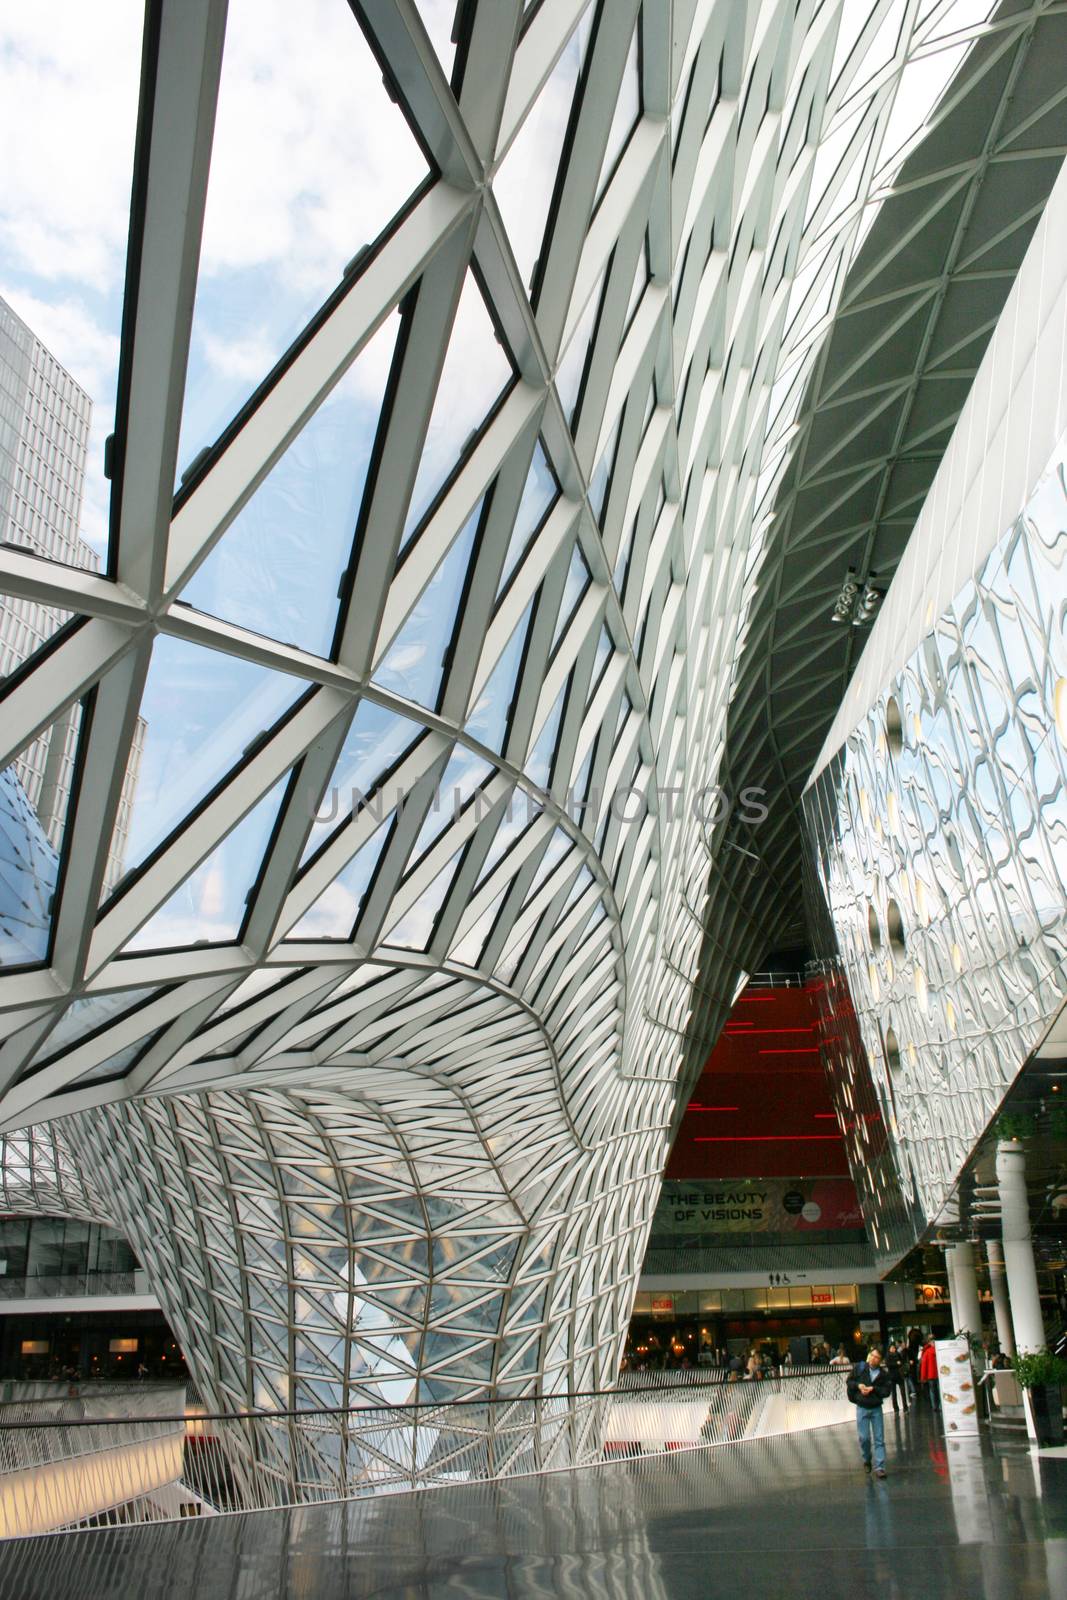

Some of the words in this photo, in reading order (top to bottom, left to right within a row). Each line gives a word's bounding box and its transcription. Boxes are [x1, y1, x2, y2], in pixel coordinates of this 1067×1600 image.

[667, 1193, 698, 1206] THE
[703, 1192, 767, 1206] BEAUTY
[674, 1209, 697, 1222] OF
[701, 1208, 763, 1221] VISIONS
